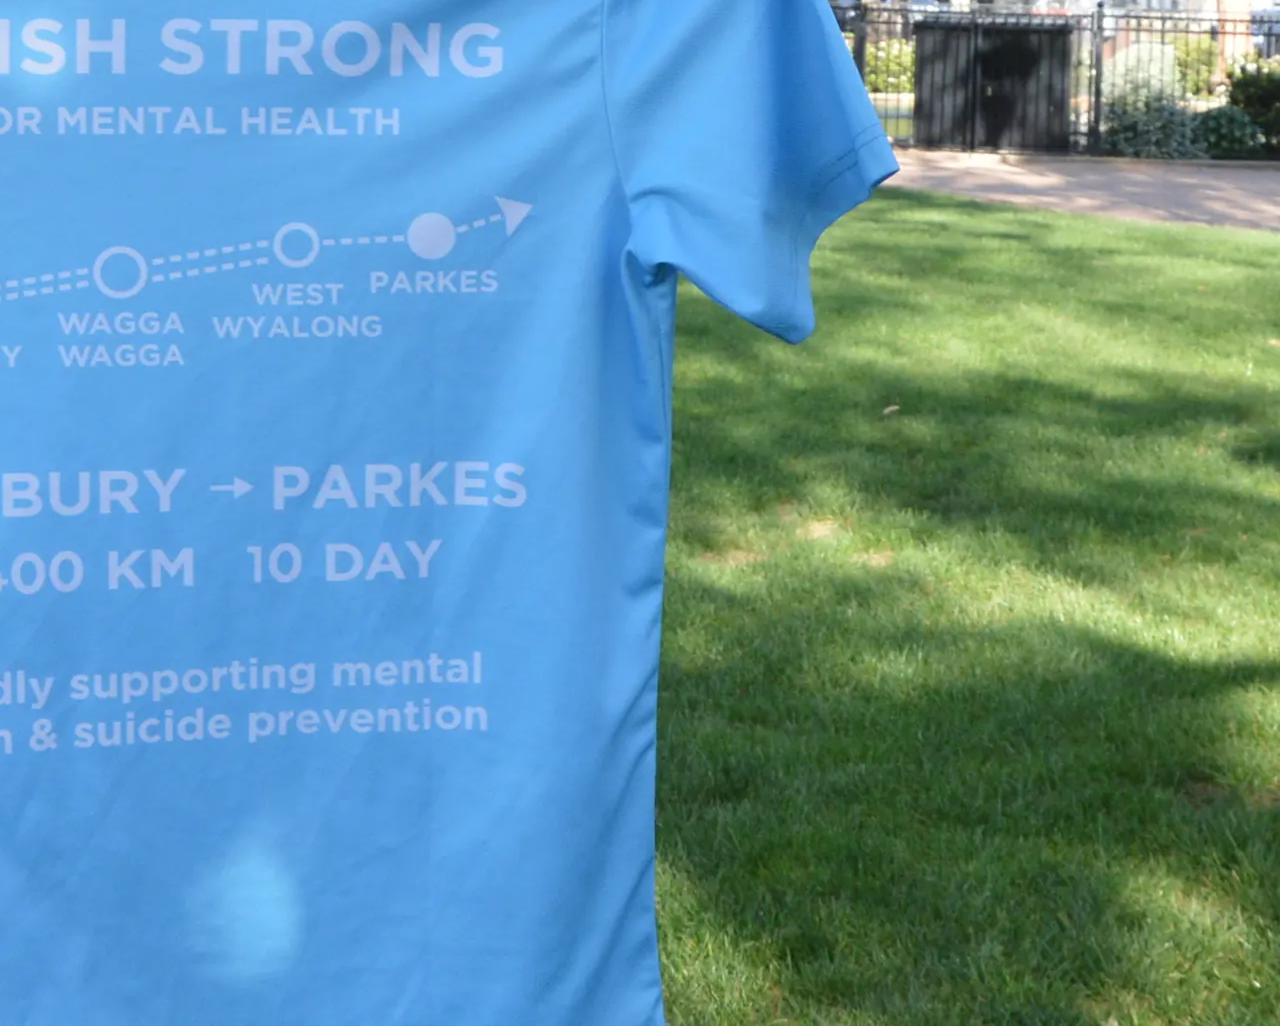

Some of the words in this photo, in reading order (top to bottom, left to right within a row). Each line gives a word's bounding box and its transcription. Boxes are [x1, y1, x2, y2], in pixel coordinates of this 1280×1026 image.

[158, 16, 505, 80] STRONG
[56, 105, 228, 136] MENTAL
[240, 105, 401, 137] HEALTH
[250, 281, 345, 307] WEST
[368, 268, 500, 295] PARKES
[56, 310, 186, 337] WAGGA
[211, 314, 384, 340] WYALONG
[57, 342, 186, 369] WAGGA
[272, 459, 528, 512] PARKES
[106, 546, 195, 591] KM
[245, 541, 304, 584] 10
[324, 538, 443, 583] DAY
[69, 656, 317, 703] supporting
[331, 649, 483, 688] mental
[27, 716, 59, 753] &
[72, 706, 233, 750] suicide
[247, 696, 490, 744] prevention
